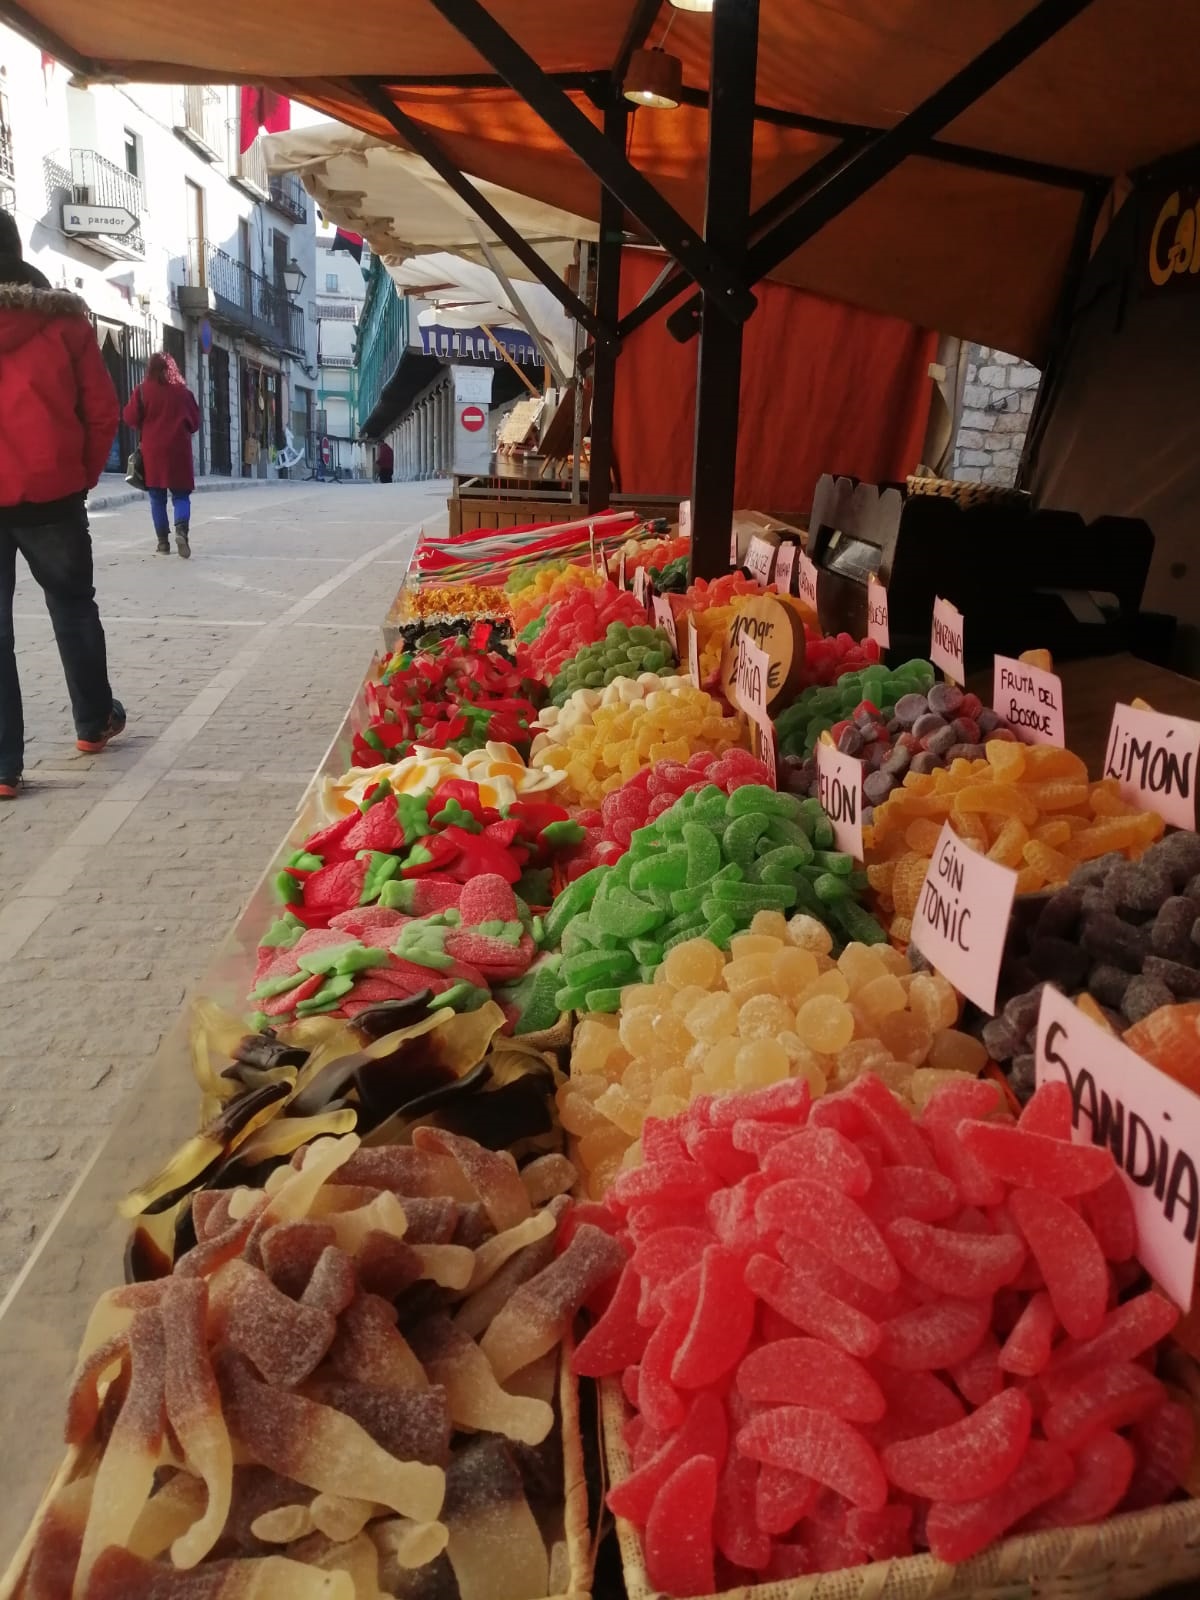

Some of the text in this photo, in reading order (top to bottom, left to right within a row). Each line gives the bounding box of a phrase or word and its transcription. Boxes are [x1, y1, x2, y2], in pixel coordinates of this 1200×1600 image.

[88, 216, 125, 225] parador
[1000, 668, 1058, 711] FRUTA DEL
[1006, 698, 1054, 736] BOSQUE
